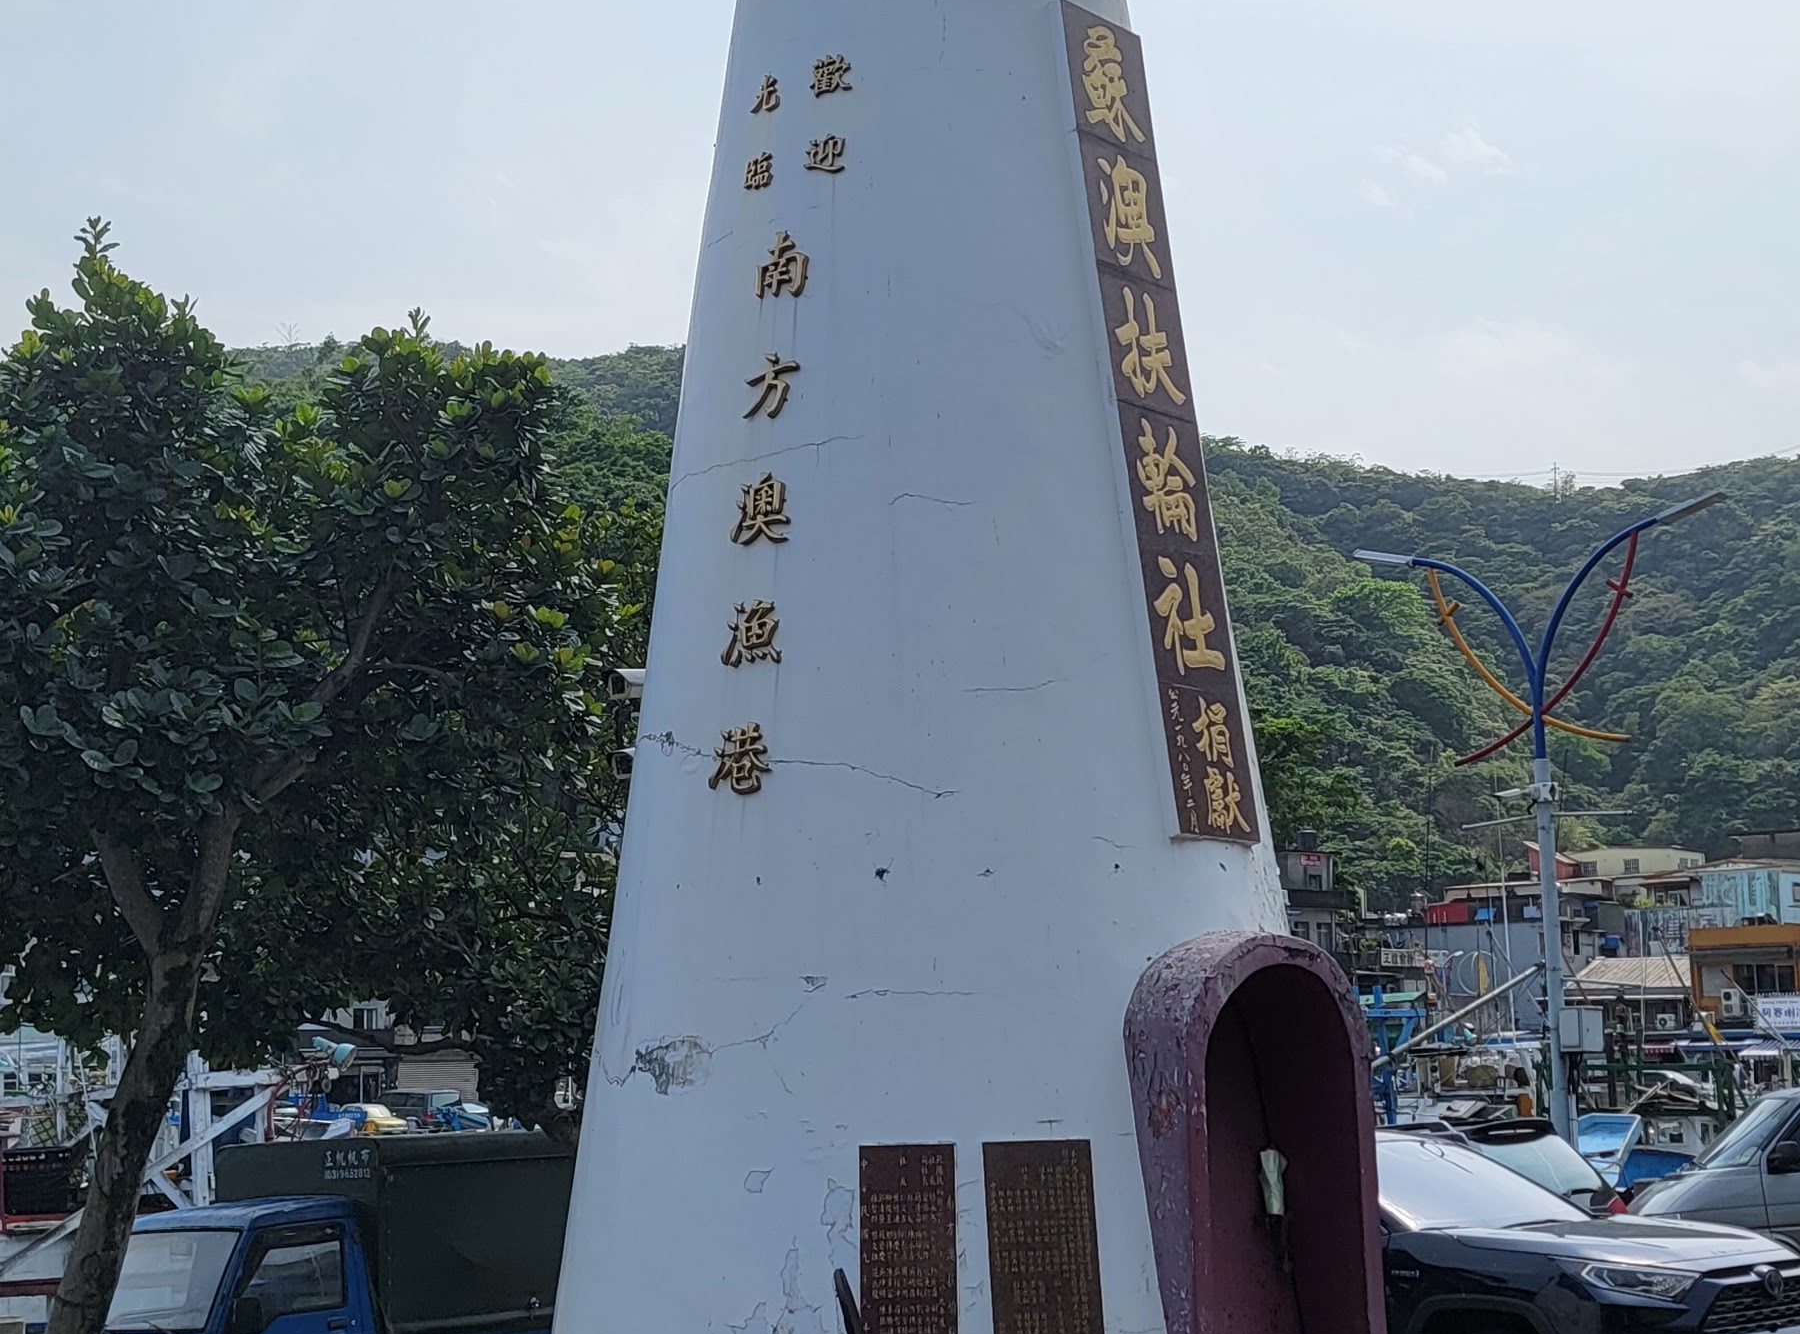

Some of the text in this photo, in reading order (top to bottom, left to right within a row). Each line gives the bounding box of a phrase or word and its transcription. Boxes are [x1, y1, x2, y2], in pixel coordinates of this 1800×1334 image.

[742, 74, 780, 190] 光臨
[803, 54, 853, 174] 歡迎
[707, 231, 810, 795] 南方澳漁港
[1082, 25, 1225, 676] 蘇澳扶輪社
[1192, 695, 1251, 835] 捐獻
